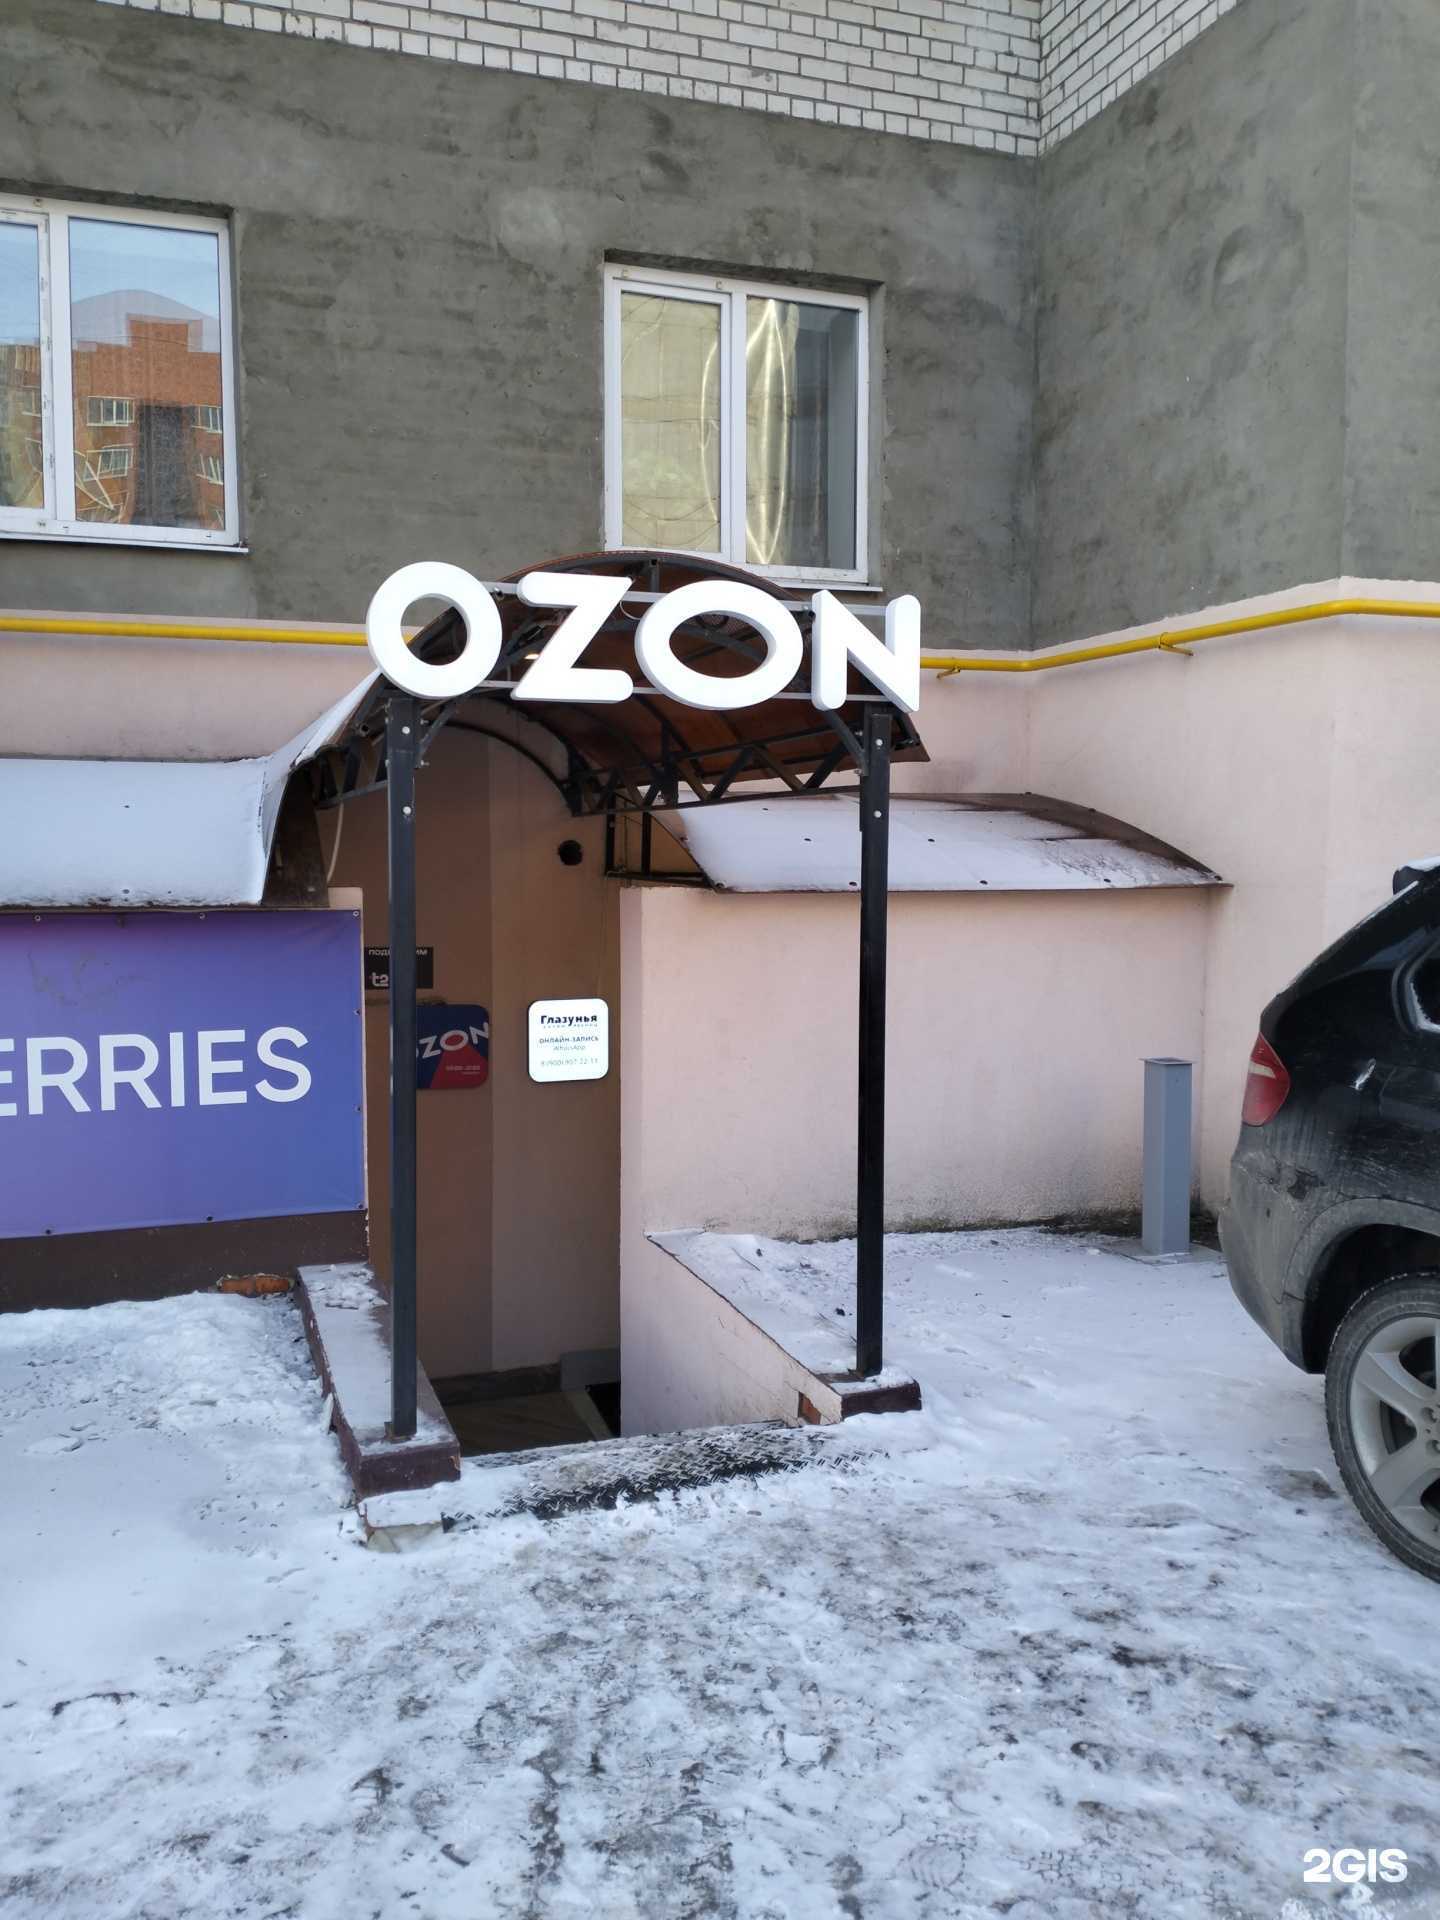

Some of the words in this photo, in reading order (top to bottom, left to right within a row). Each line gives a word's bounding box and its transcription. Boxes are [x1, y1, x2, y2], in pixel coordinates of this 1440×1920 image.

[366, 561, 921, 713] OZON
[540, 1014, 598, 1027] Глазунья
[416, 1022, 489, 1059] ZON
